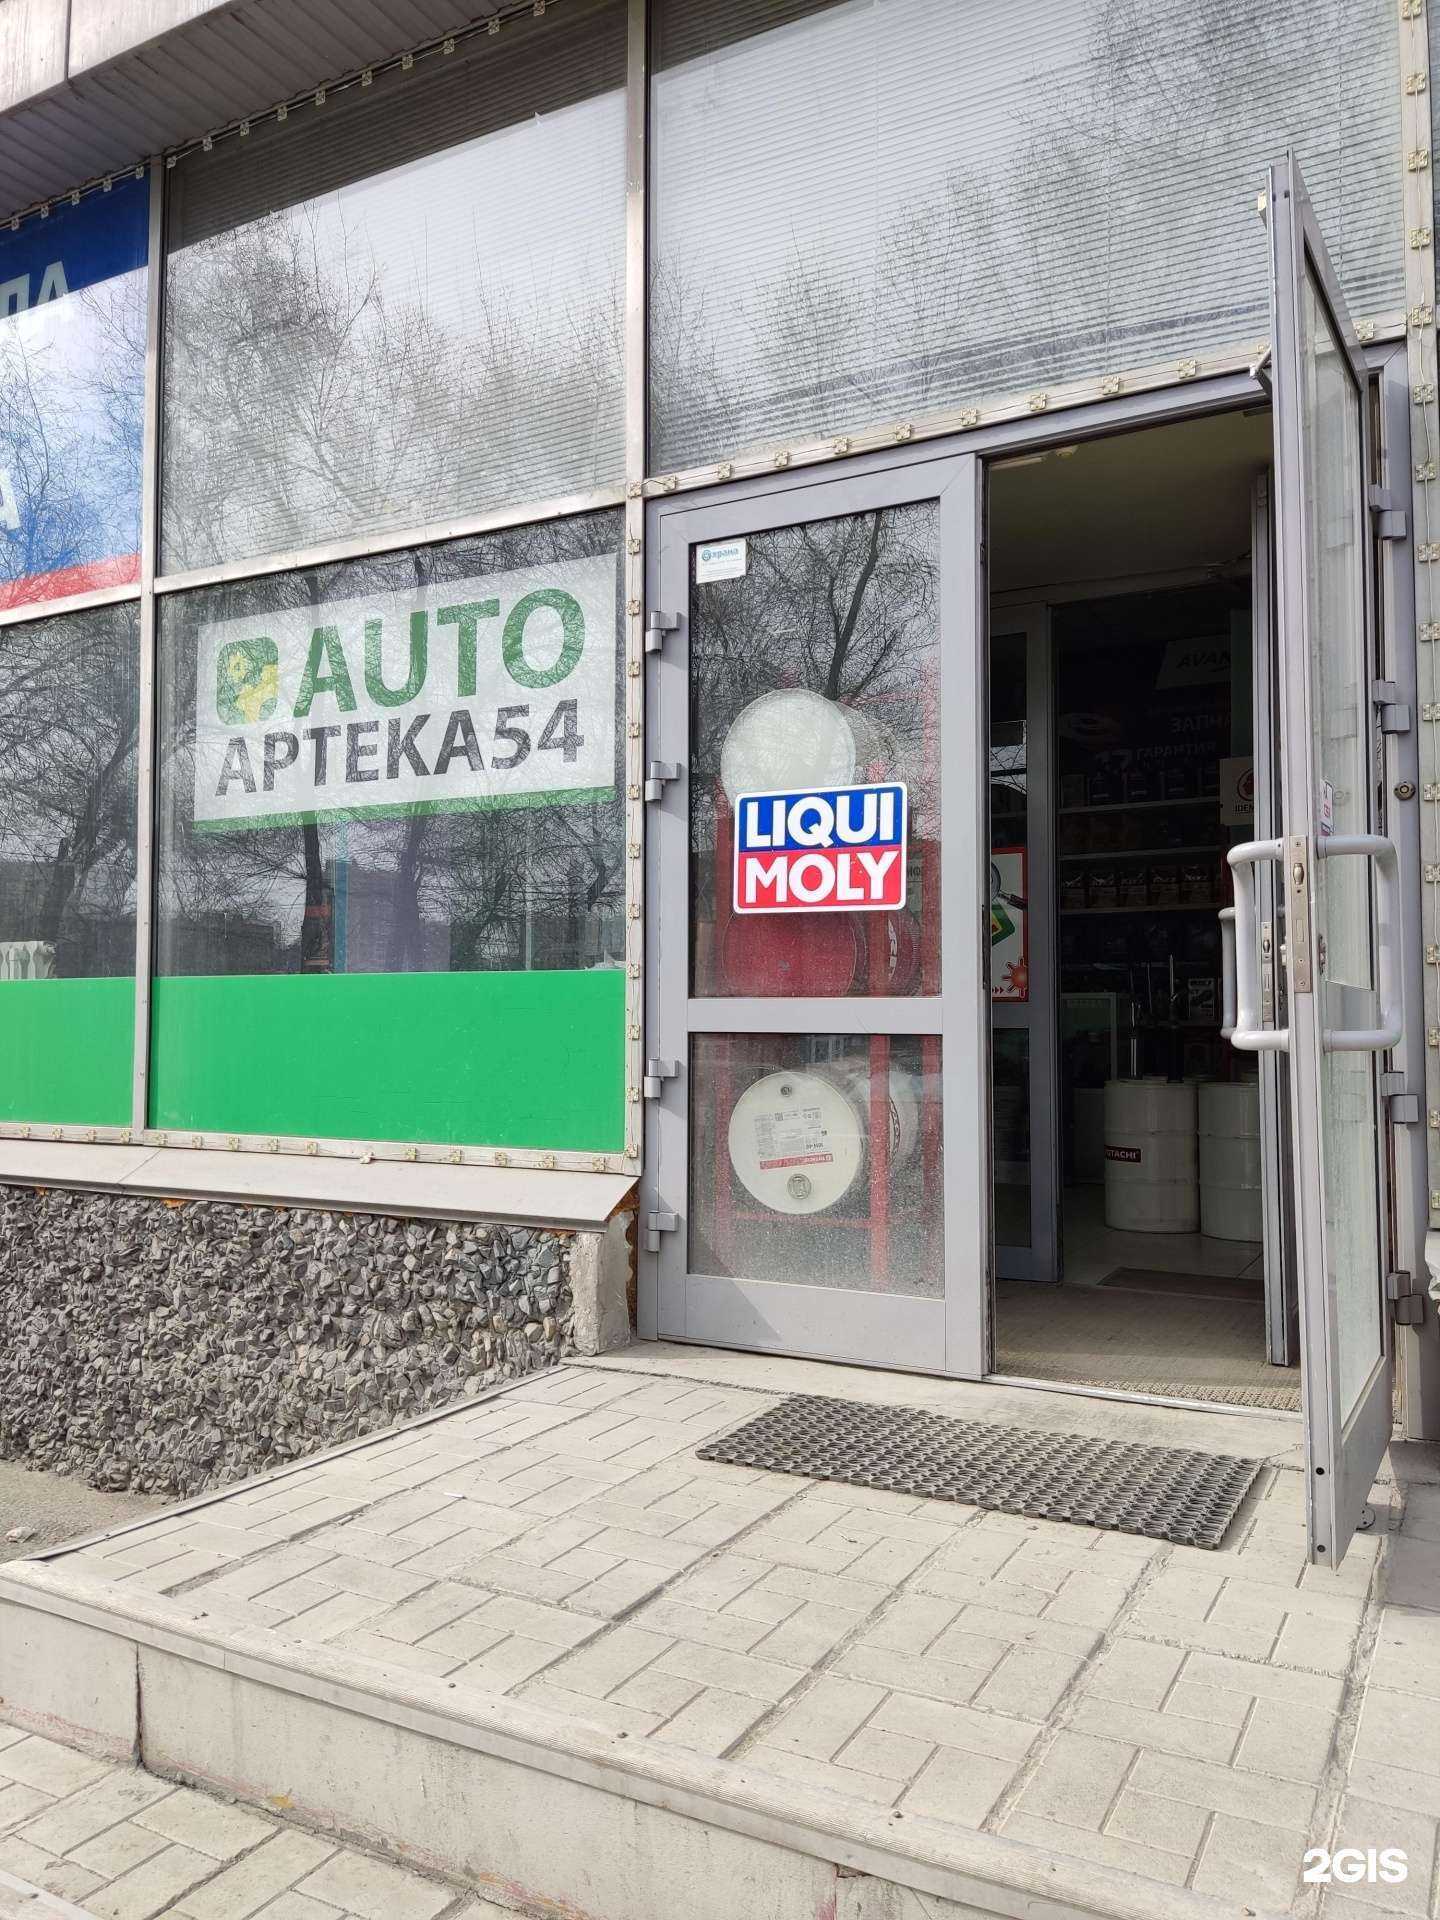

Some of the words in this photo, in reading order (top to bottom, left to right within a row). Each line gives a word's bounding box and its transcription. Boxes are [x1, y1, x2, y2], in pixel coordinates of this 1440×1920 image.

[293, 588, 586, 718] AUTO
[215, 698, 585, 797] APTEKA54
[746, 791, 895, 849] LIQUI
[745, 849, 899, 904] MOLY
[1104, 1149, 1137, 1160] TACHI
